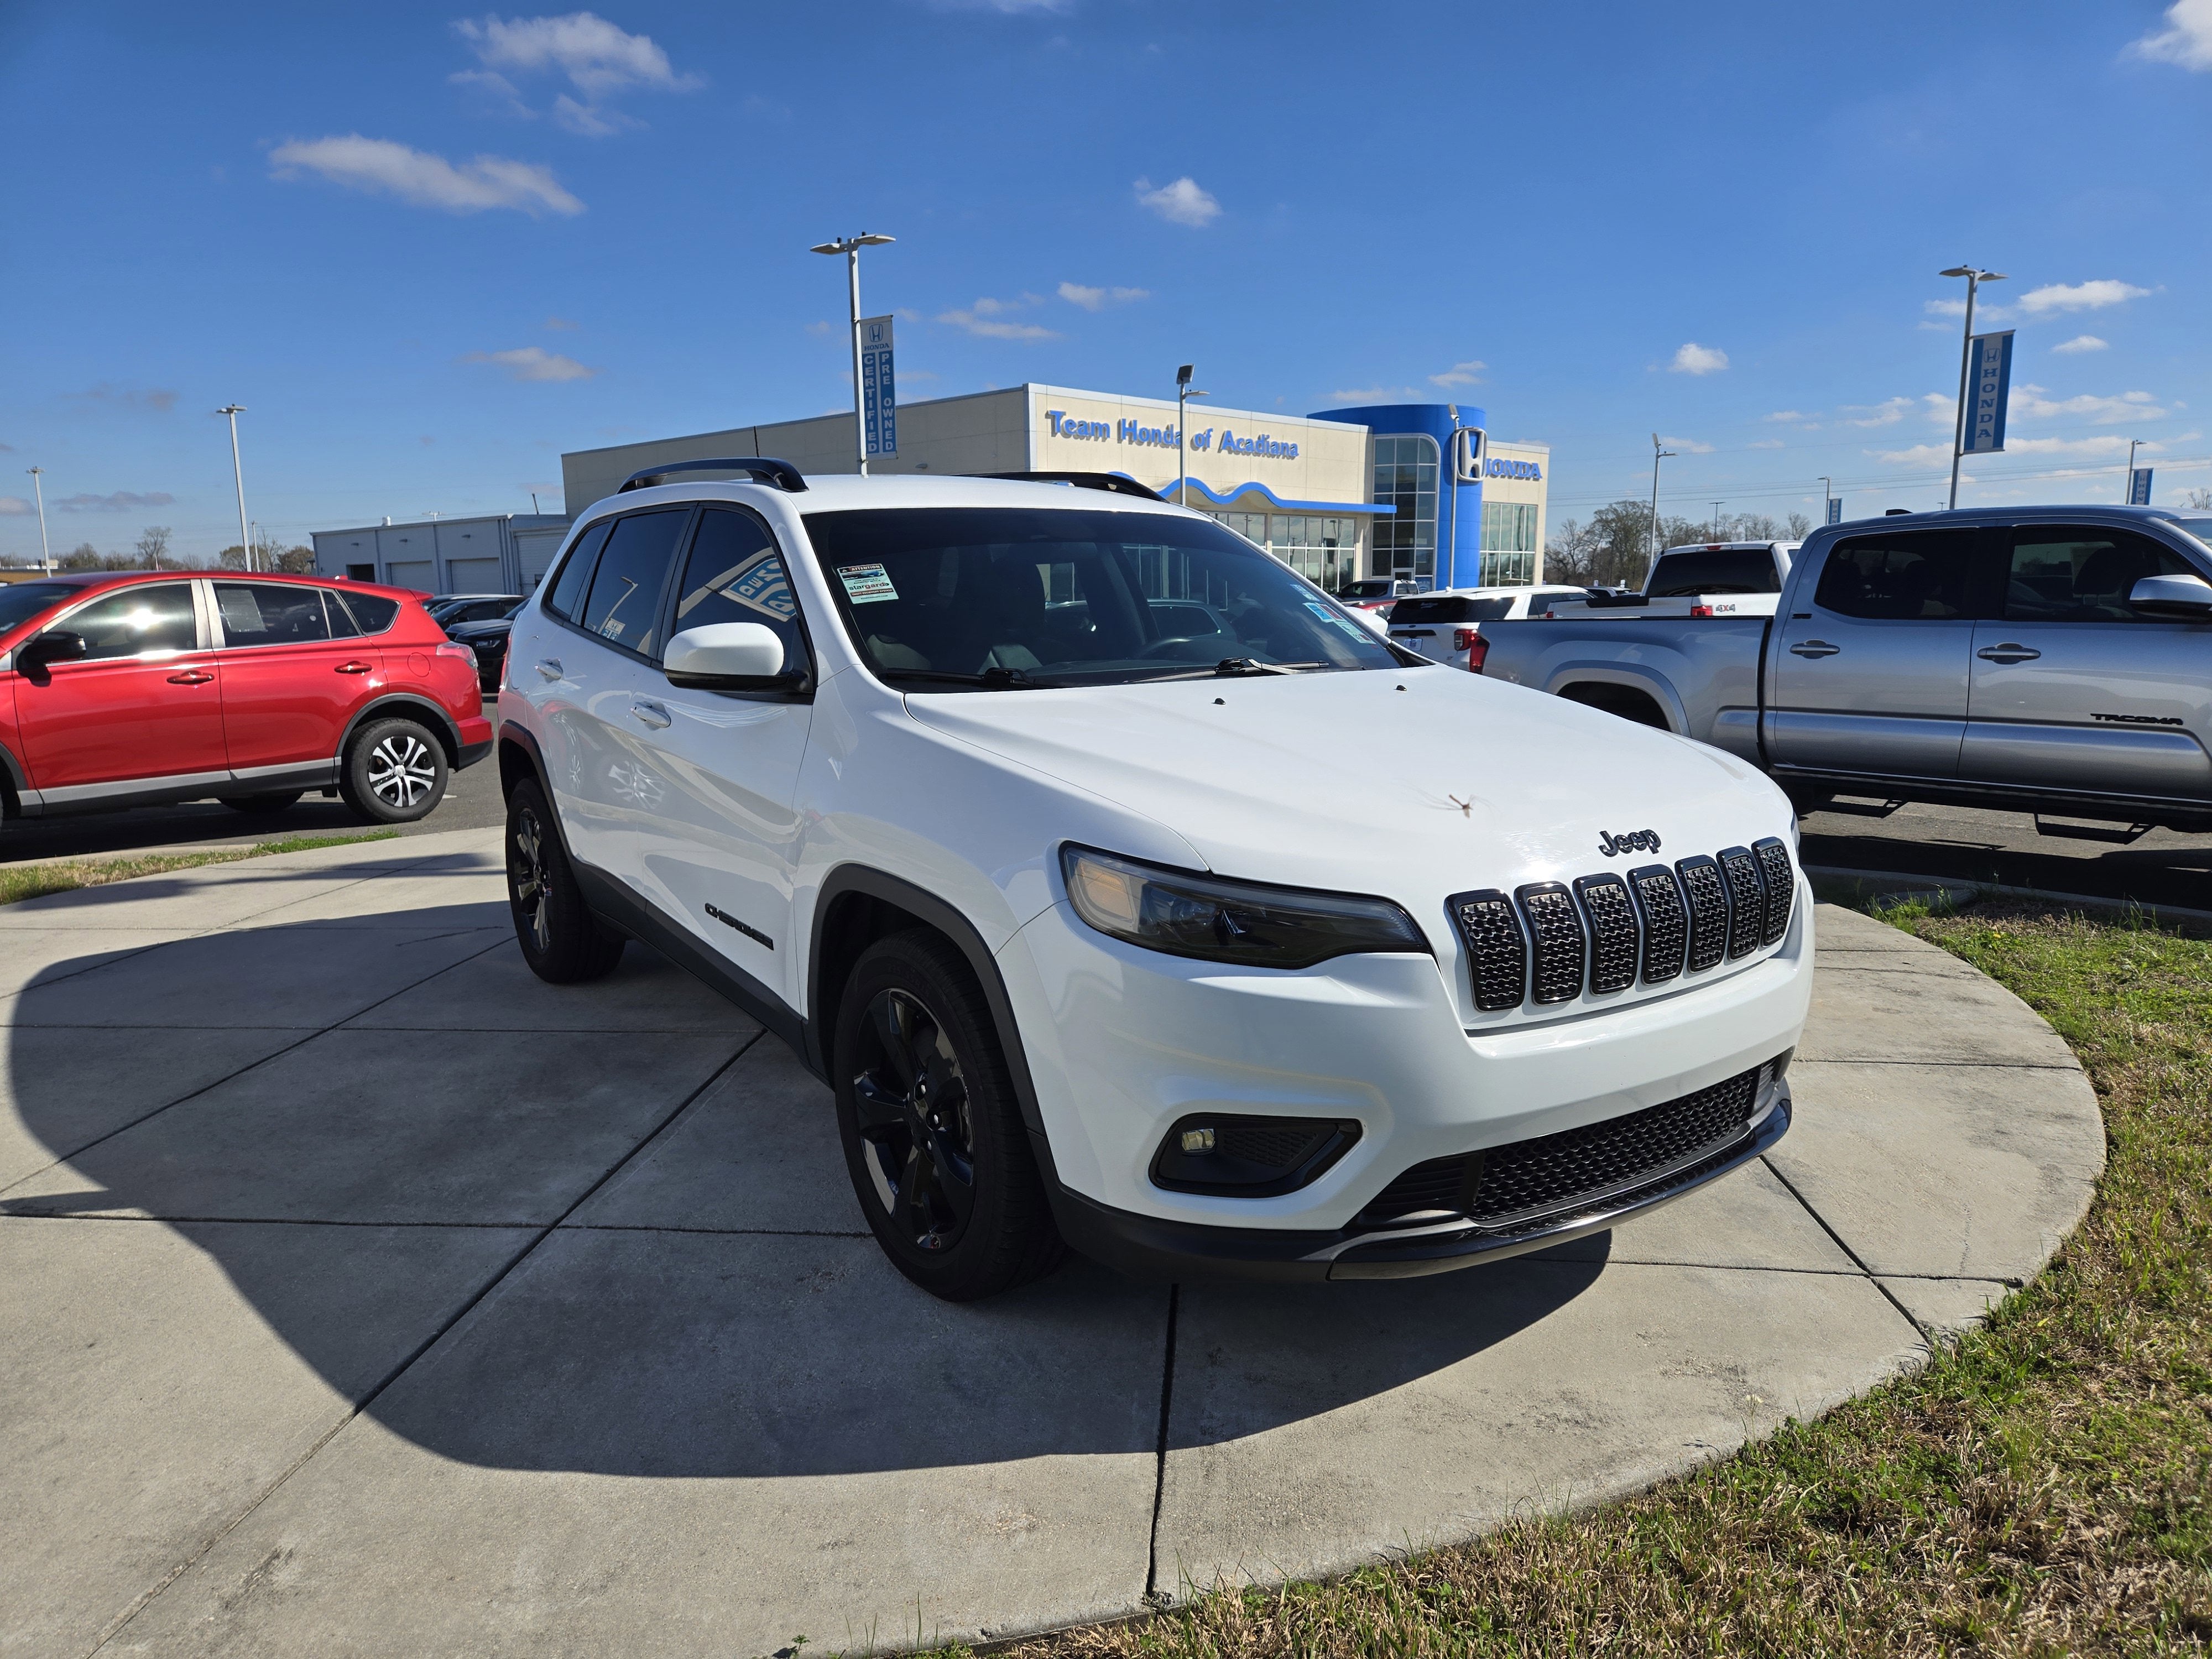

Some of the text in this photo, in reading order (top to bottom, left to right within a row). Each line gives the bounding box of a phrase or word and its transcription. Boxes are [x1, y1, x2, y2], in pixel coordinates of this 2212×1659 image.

[864, 343, 889, 351] HONDA
[864, 355, 877, 452] CERTIFIED
[881, 353, 894, 451] PRE OWNED
[1977, 368, 1998, 438] HONDA
[1048, 410, 1110, 439] Team
[1194, 427, 1214, 448] of
[1221, 430, 1299, 457] Acadiana
[849, 582, 885, 591] stargard
[2090, 713, 2183, 726] TACOMA
[1598, 829, 1661, 858] Jeep
